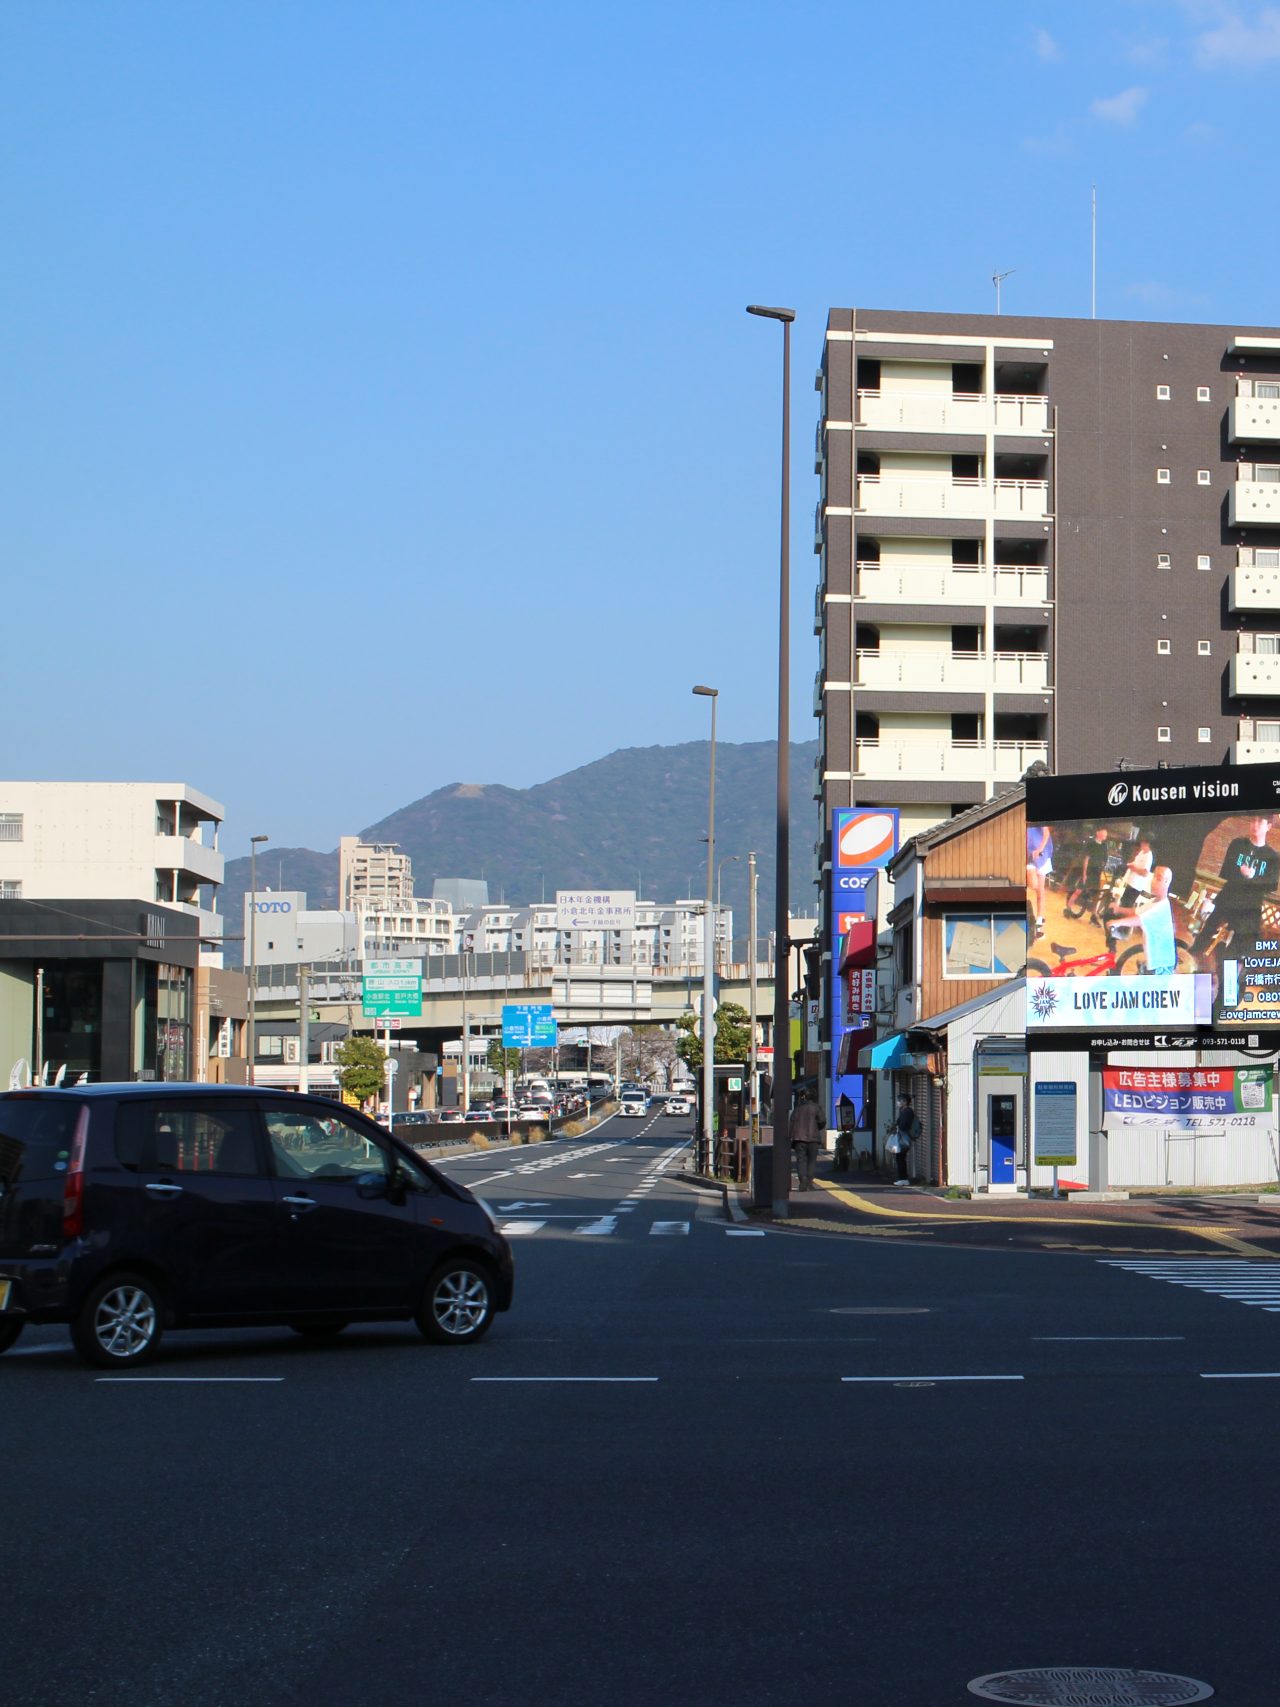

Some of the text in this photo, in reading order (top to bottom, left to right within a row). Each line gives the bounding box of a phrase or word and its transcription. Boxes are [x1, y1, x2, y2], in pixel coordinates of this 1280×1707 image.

[1133, 781, 1239, 802] Kousen vision
[840, 877, 869, 888] COS
[560, 896, 611, 904] 日本年金機構
[249, 902, 291, 913] TOTO
[1256, 941, 1278, 950] BMX
[1074, 992, 1108, 1010] LOVE
[1112, 991, 1138, 1009] JAM
[1142, 990, 1180, 1008] CREW
[1119, 1071, 1220, 1088] 広告主様募集中
[1114, 1093, 1226, 1110] LEDビジョン販売中
